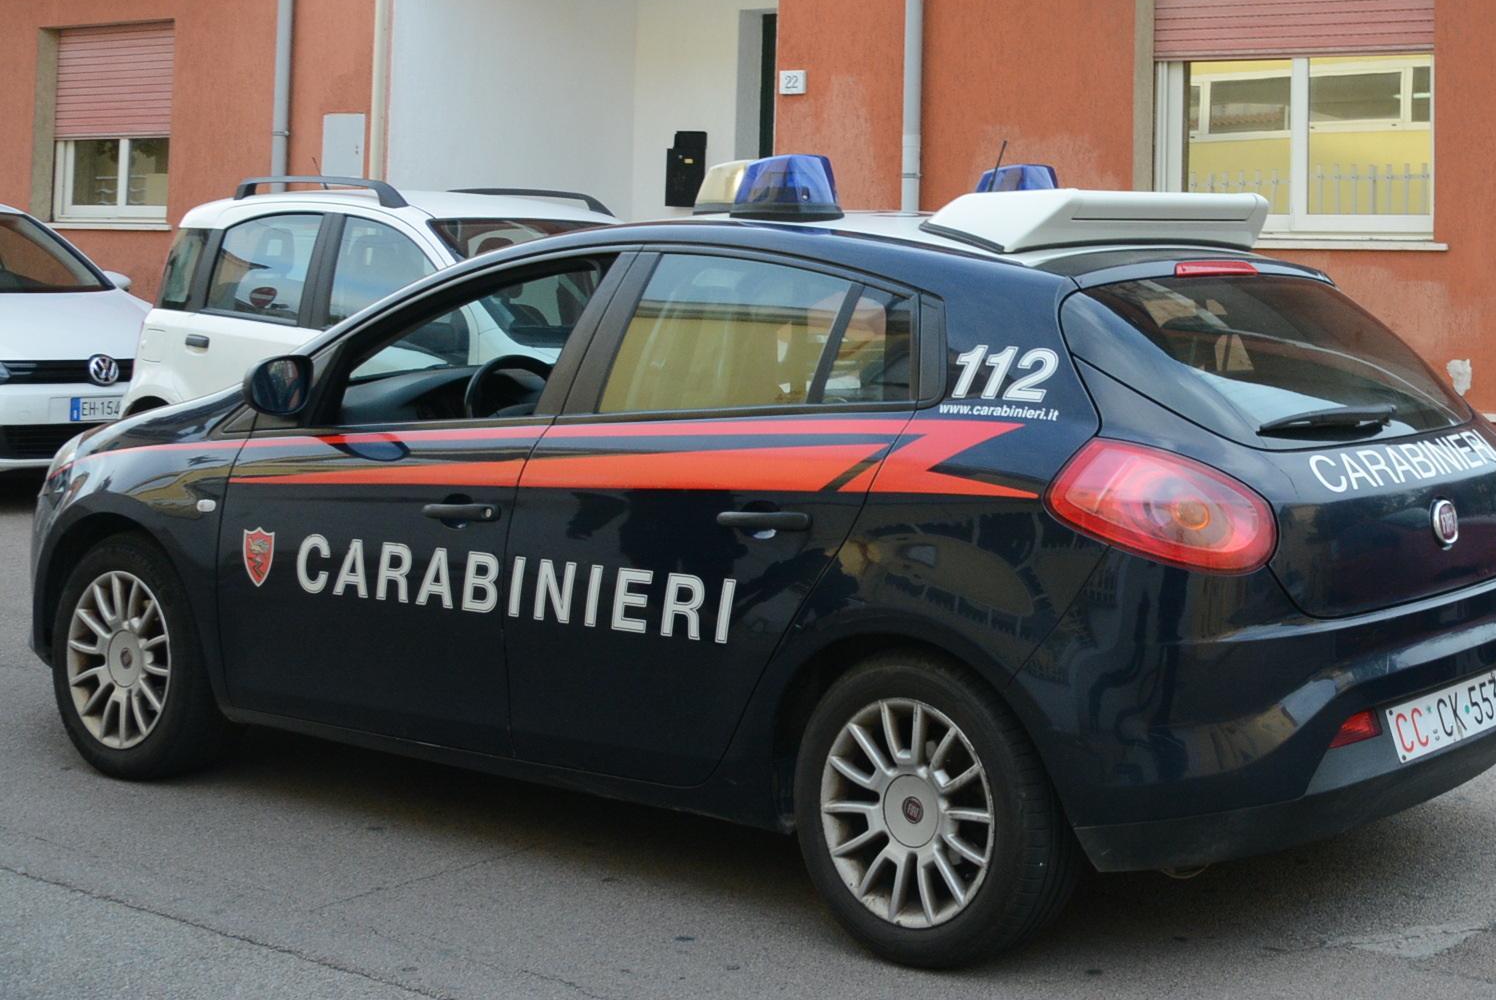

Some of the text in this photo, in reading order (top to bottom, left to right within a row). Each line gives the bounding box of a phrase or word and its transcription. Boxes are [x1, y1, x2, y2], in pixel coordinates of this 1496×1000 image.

[784, 74, 799, 90] 22
[951, 344, 1060, 403] 112
[939, 403, 1060, 421] www.carabinieri.it
[296, 533, 737, 644] CARABINIERI
[1395, 707, 1430, 753] CC
[1436, 691, 1468, 737] CK
